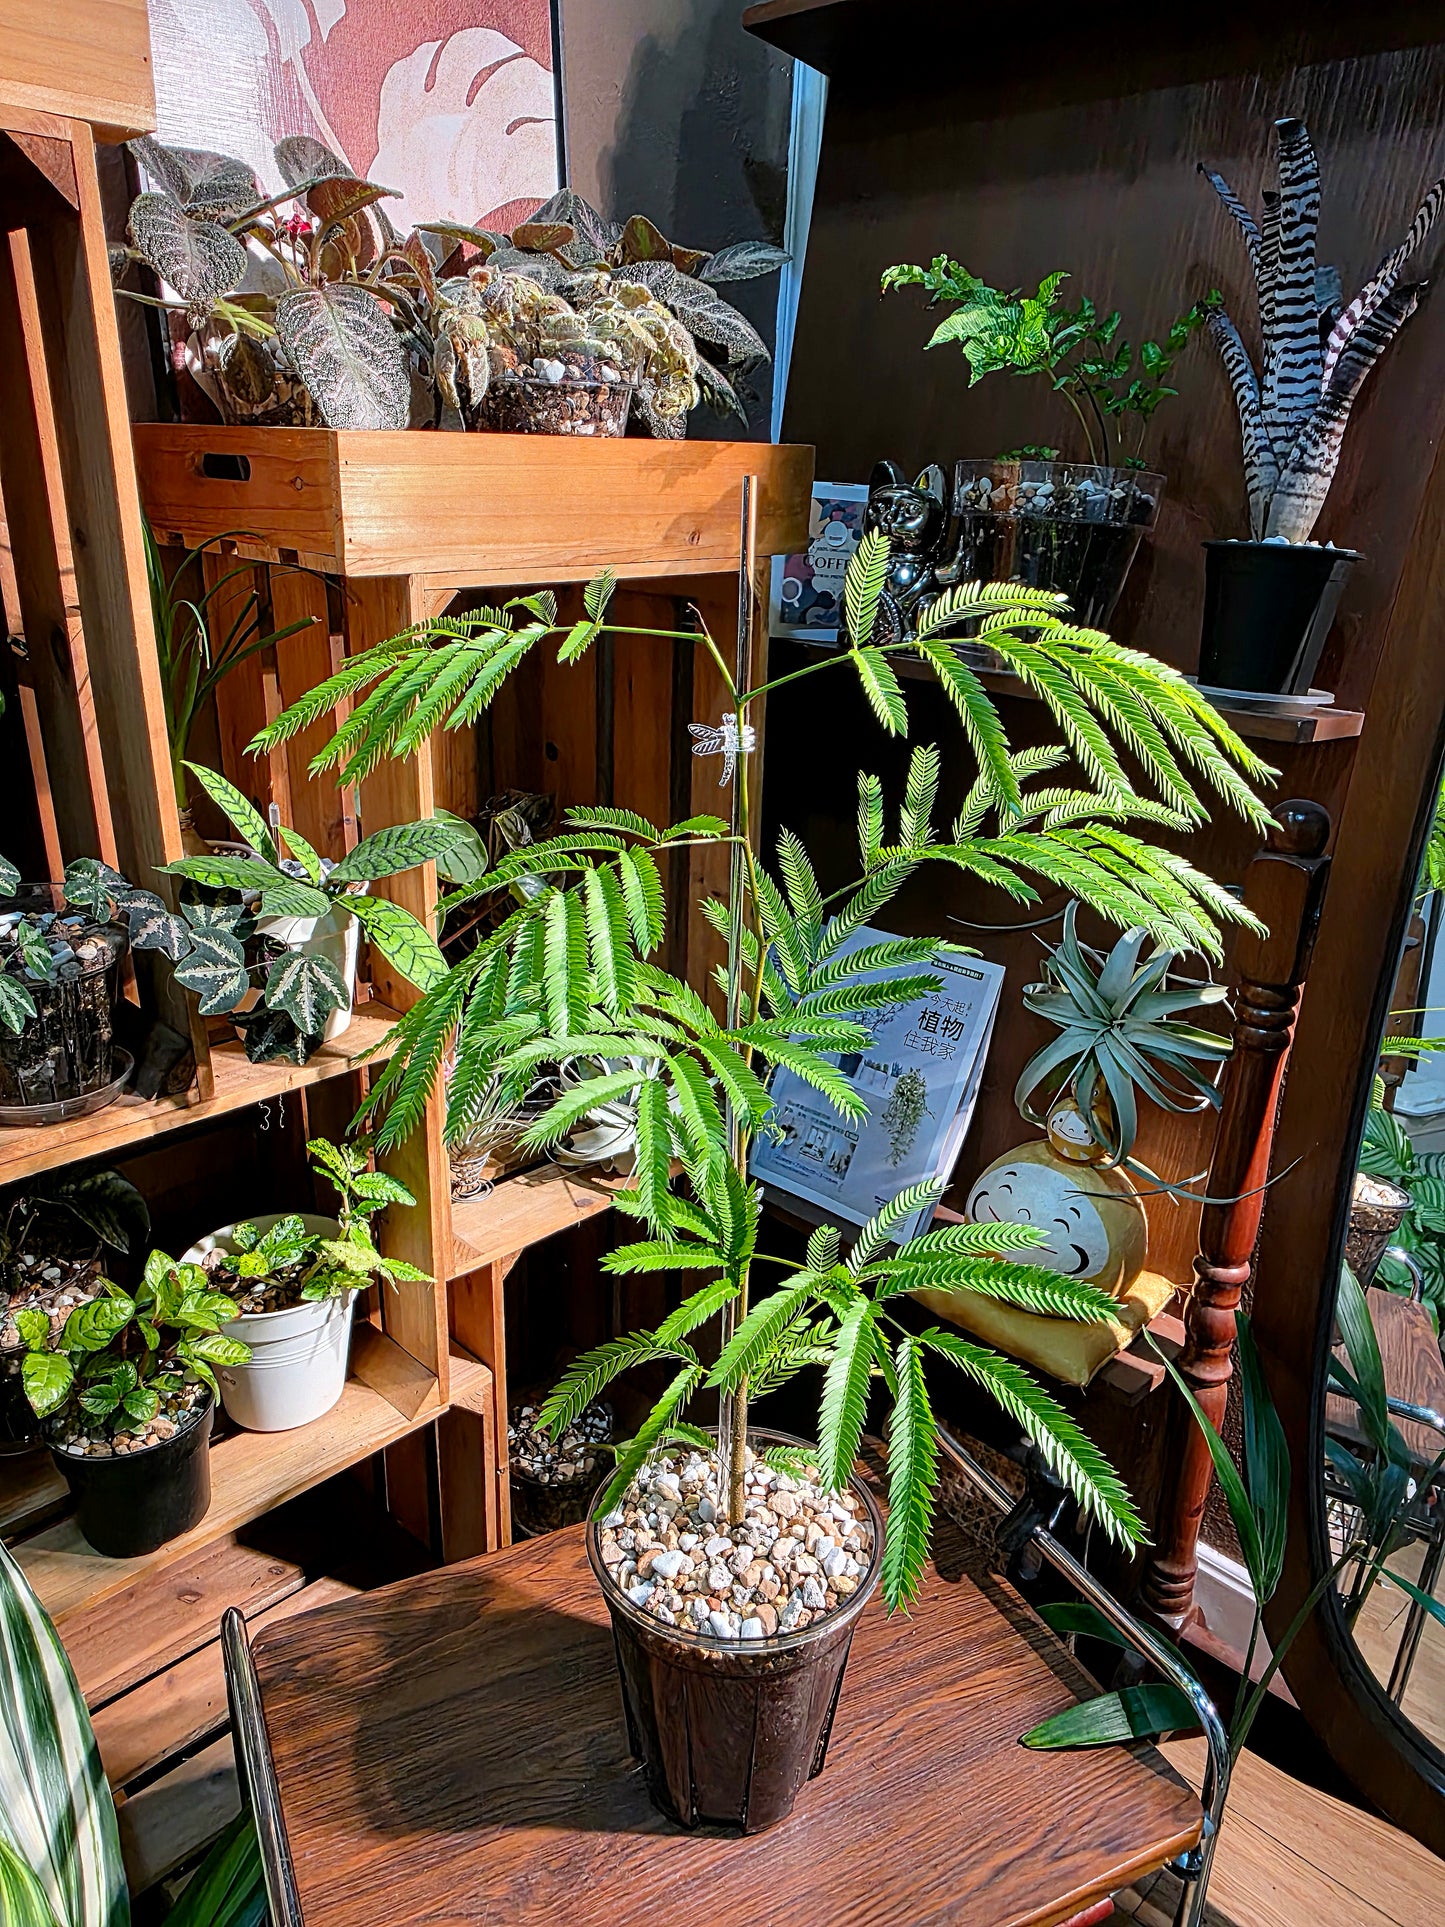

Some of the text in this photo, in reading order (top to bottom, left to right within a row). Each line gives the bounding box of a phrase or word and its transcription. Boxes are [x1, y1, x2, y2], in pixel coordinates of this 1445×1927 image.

[803, 554, 851, 570] COFF
[918, 1007, 965, 1041] 植物
[904, 1029, 957, 1061] 住我家
